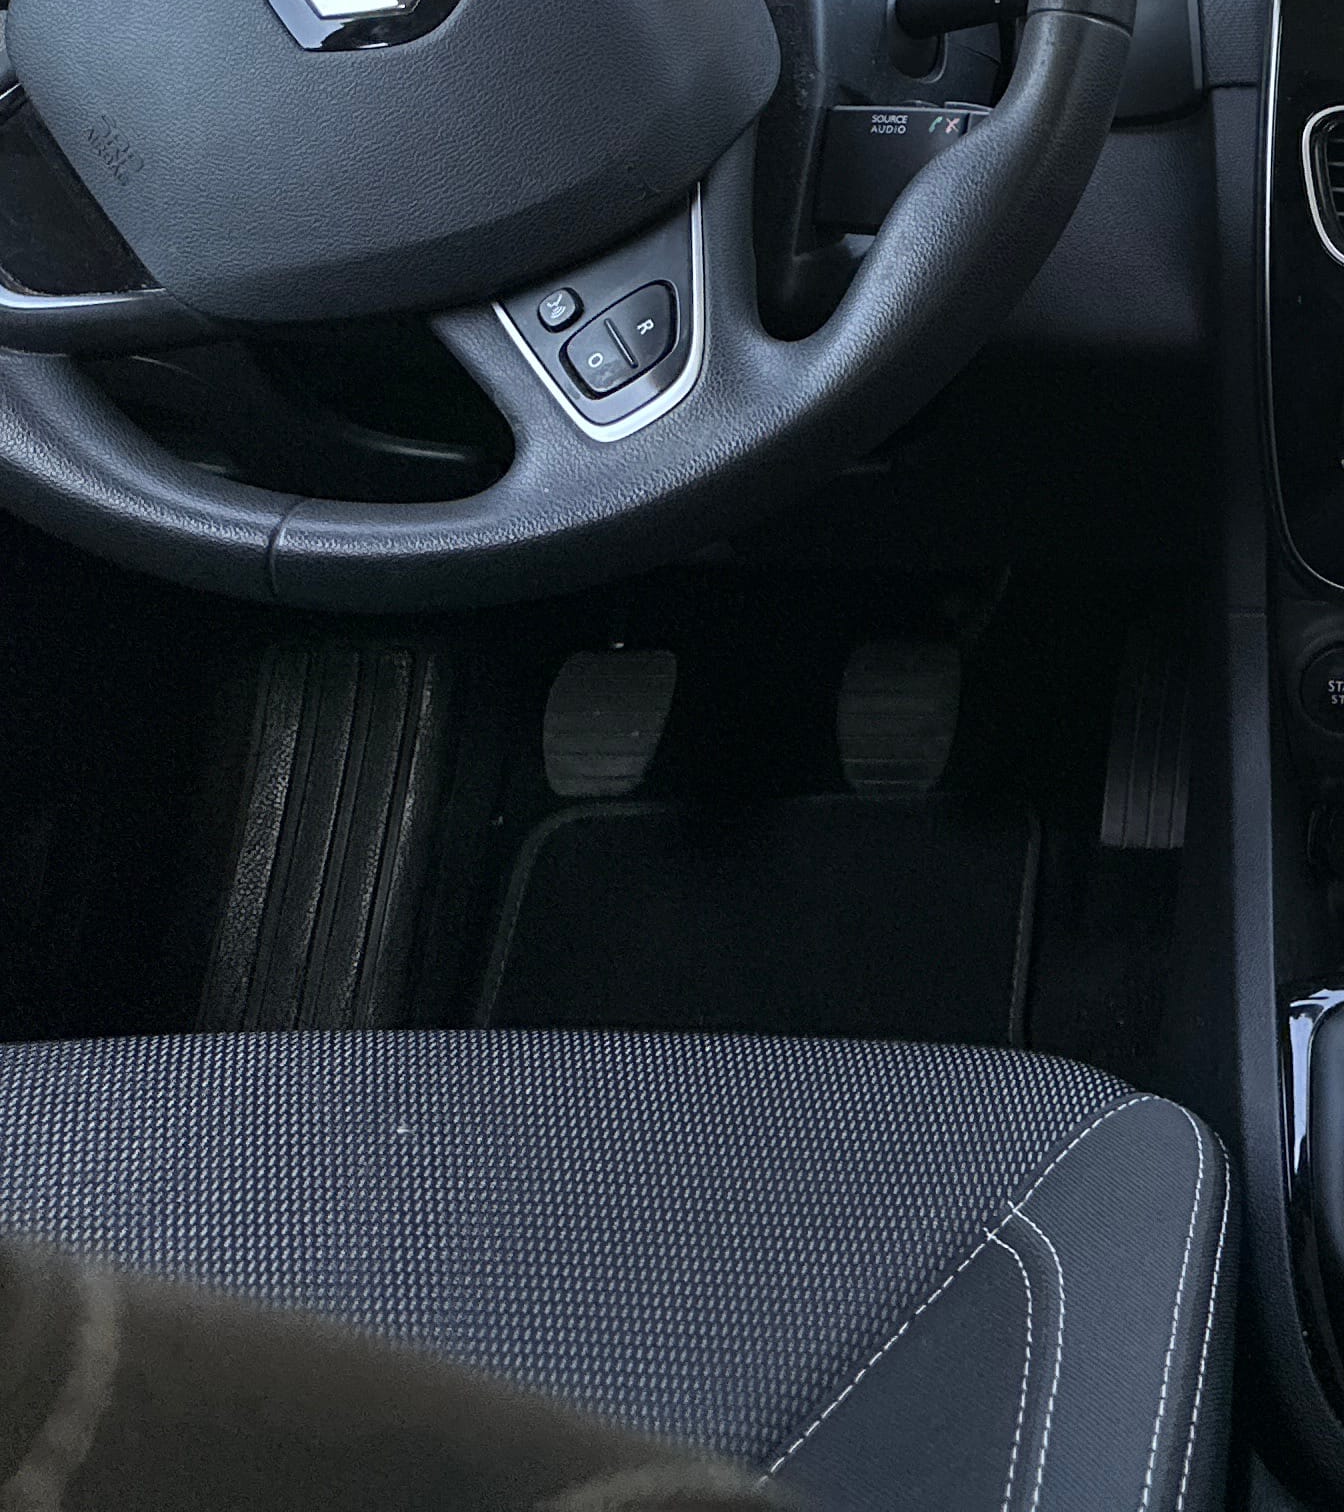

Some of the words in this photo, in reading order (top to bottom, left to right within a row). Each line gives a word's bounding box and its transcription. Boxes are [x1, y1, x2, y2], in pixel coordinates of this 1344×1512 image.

[871, 114, 909, 124] SOURCE
[870, 125, 907, 134] AUDIO
[636, 318, 655, 335] R
